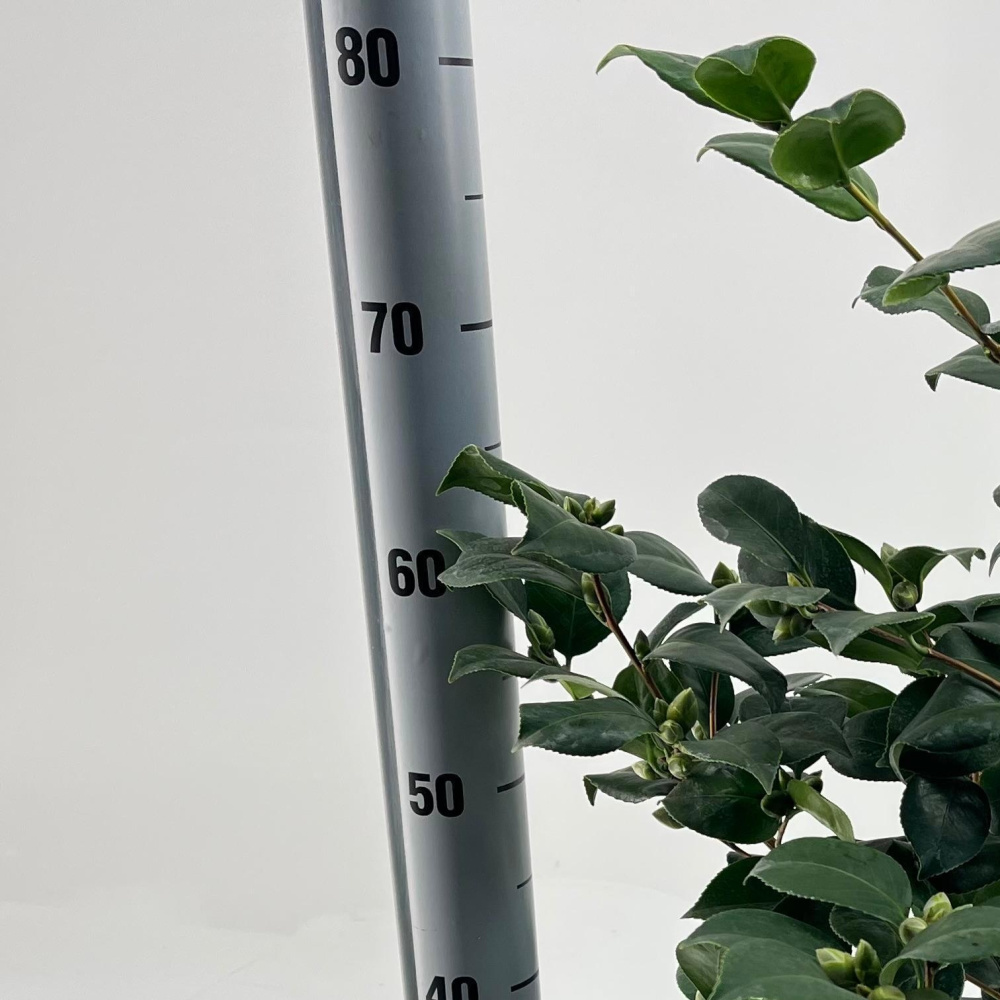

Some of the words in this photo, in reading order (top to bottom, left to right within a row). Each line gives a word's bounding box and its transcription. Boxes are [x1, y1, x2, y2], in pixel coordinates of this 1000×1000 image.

[335, 26, 401, 87] 80
[361, 301, 424, 356] 70
[387, 548, 447, 598] 60
[408, 772, 465, 818] 50
